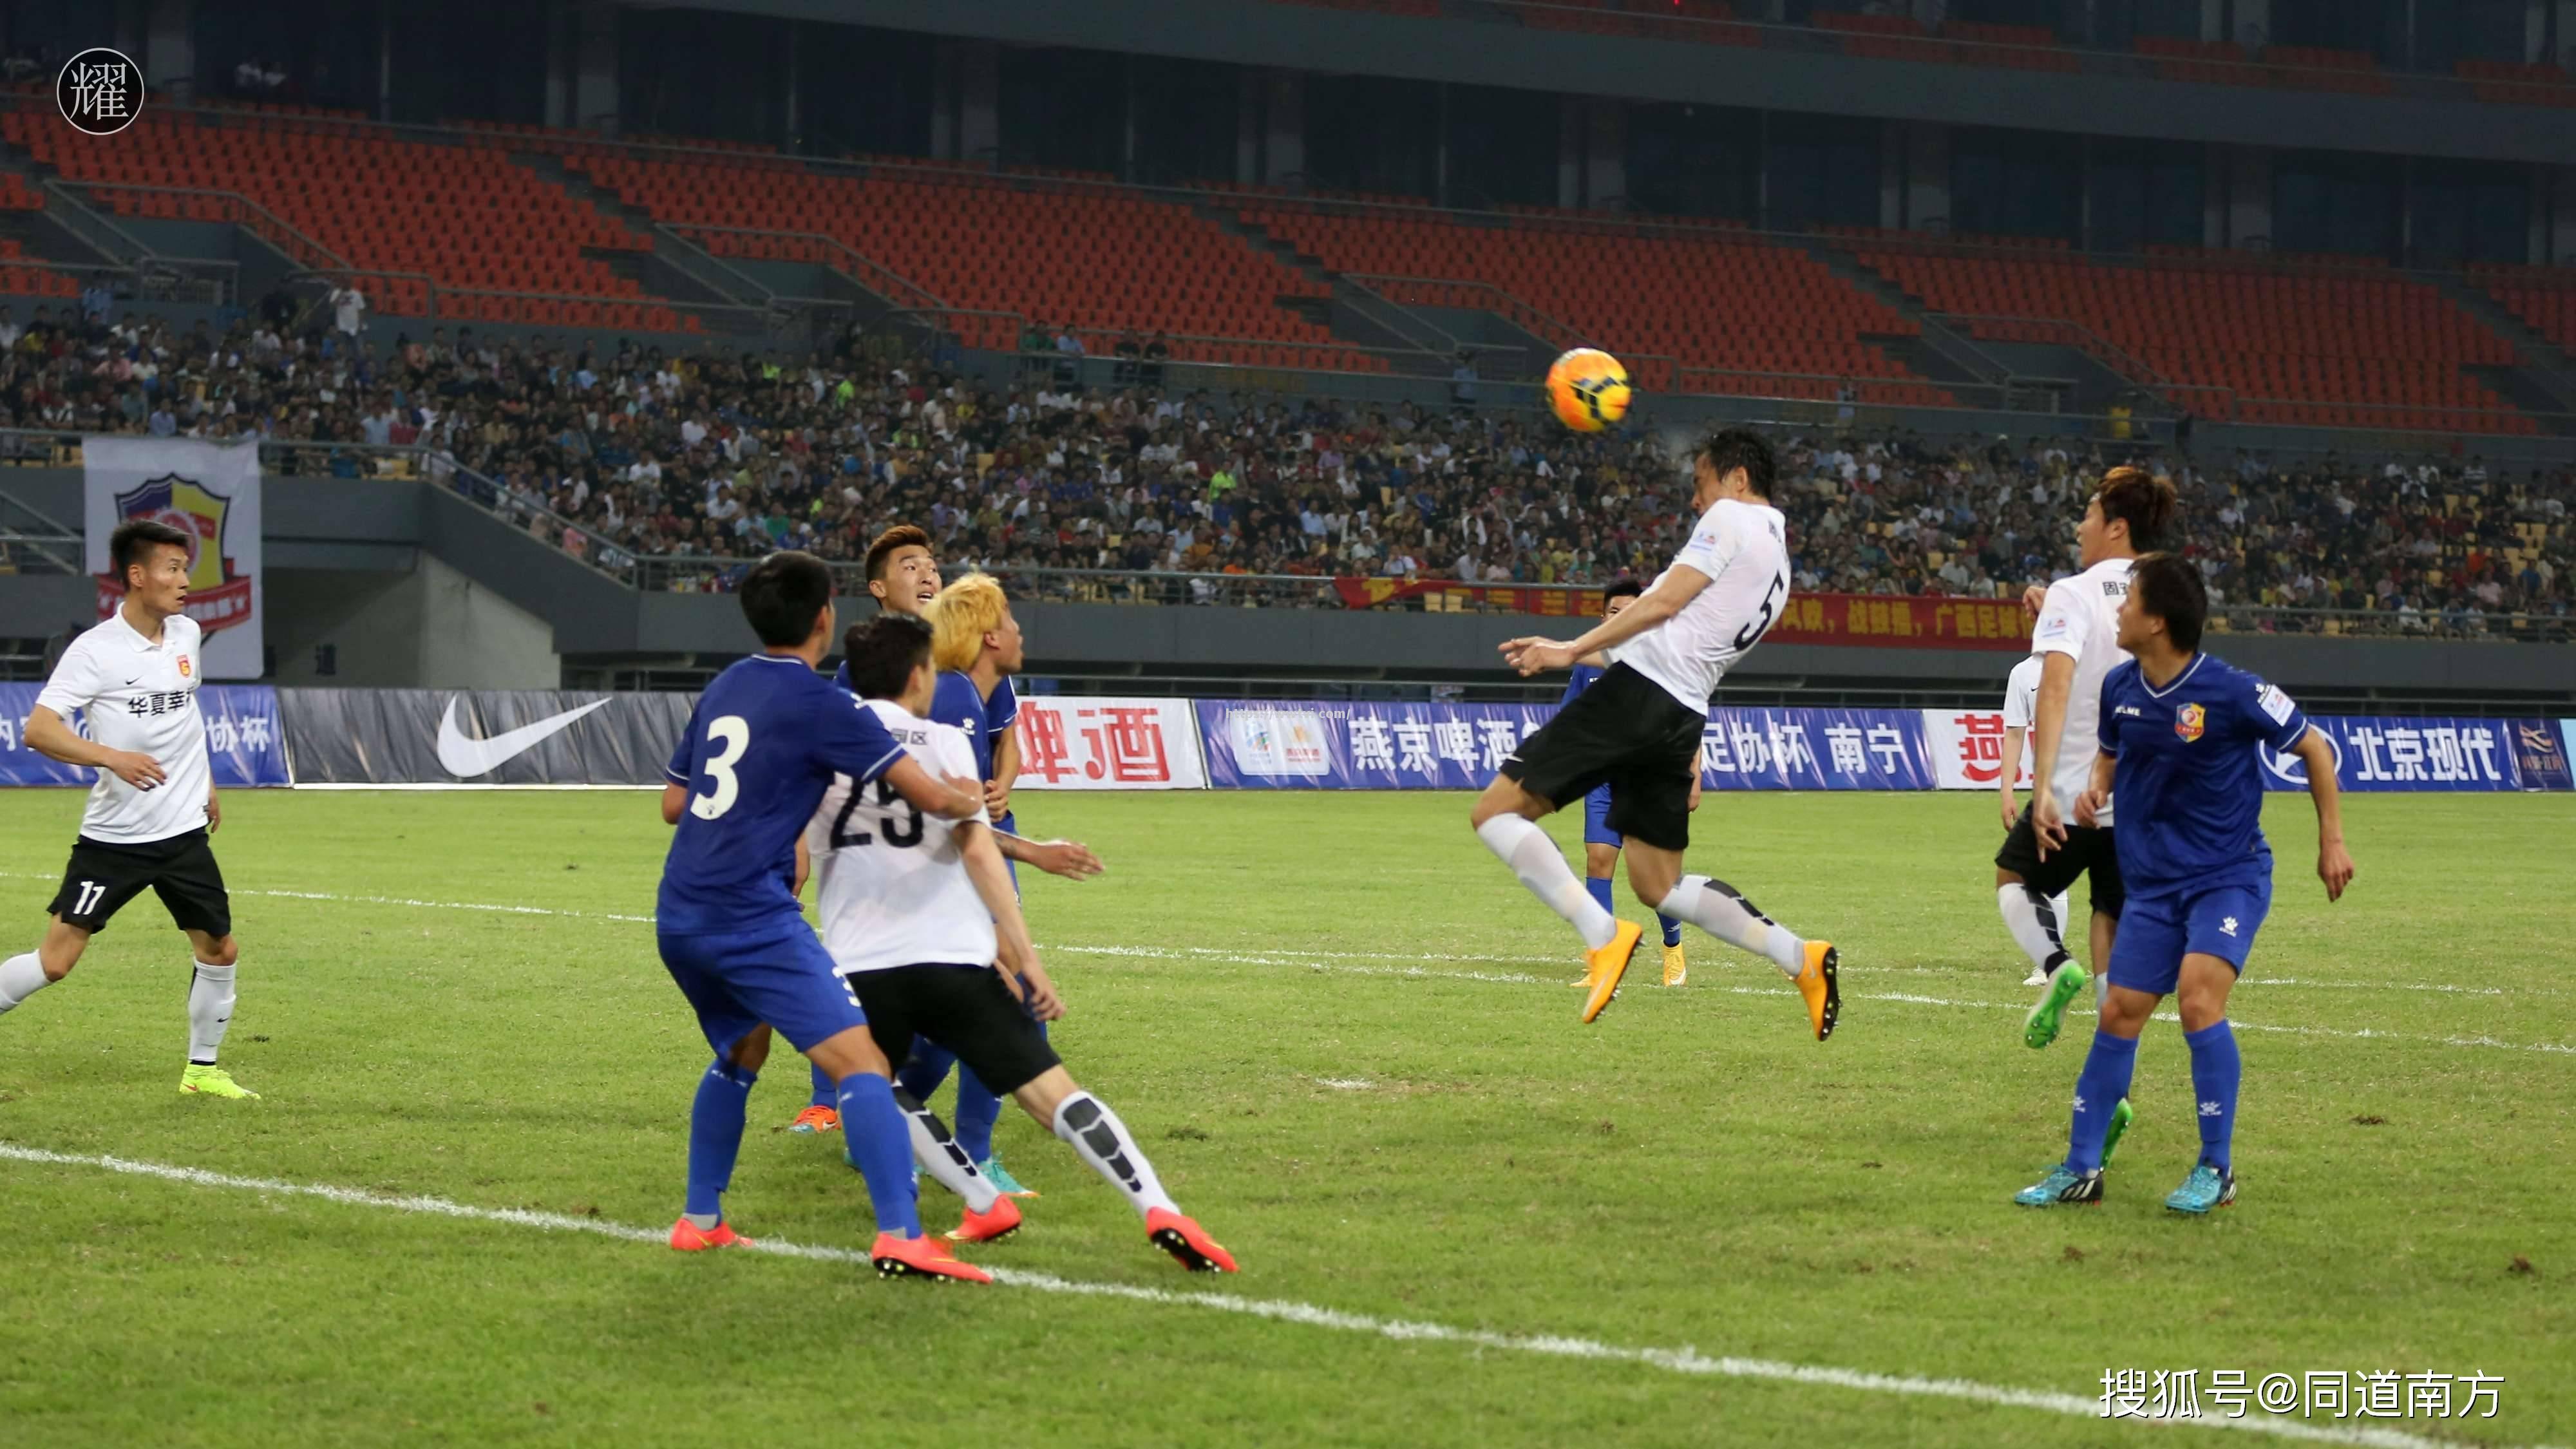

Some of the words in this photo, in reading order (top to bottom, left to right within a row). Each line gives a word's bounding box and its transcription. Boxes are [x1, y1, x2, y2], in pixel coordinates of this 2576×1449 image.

[1734, 570, 1784, 651] 5
[690, 715, 750, 820] 3
[1824, 722, 1904, 773] 南宁
[2349, 726, 2502, 781] 北京现代
[829, 778, 923, 851] 25
[73, 880, 106, 916] 11
